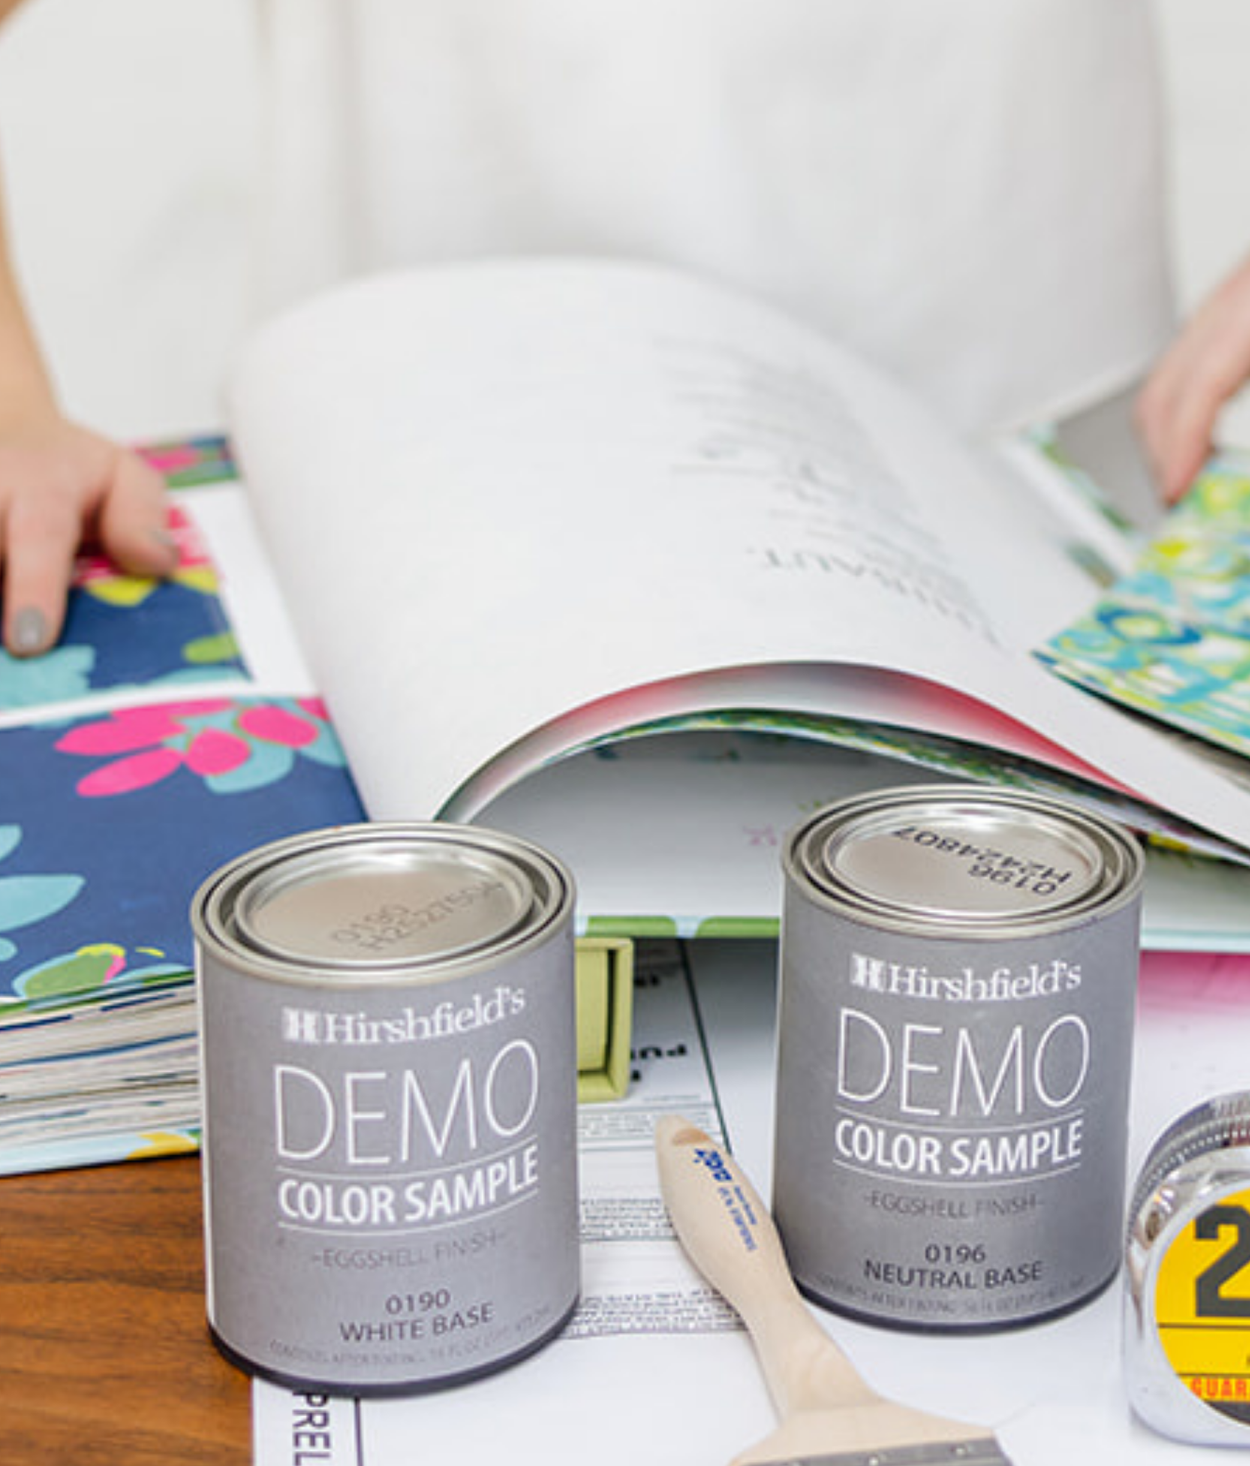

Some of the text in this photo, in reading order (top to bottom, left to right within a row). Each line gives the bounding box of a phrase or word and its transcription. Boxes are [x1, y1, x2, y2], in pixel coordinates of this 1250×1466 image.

[966, 864, 1057, 897] 0196
[890, 957, 1082, 1002] Hirshfield's
[322, 987, 526, 1044] Hirshfield's
[836, 1006, 1091, 1118] DEMO
[272, 1037, 540, 1167] DEMO
[834, 1119, 1084, 1177] COLOR SAMPLE
[278, 1177, 397, 1225] COLOR
[404, 1144, 539, 1222] SAMPLE
[863, 1260, 1044, 1290] NEUTRAL BASE
[924, 1244, 987, 1265] 0196
[338, 1317, 424, 1343] WHITE
[430, 1301, 495, 1334] BASE
[386, 1289, 452, 1316] 0190
